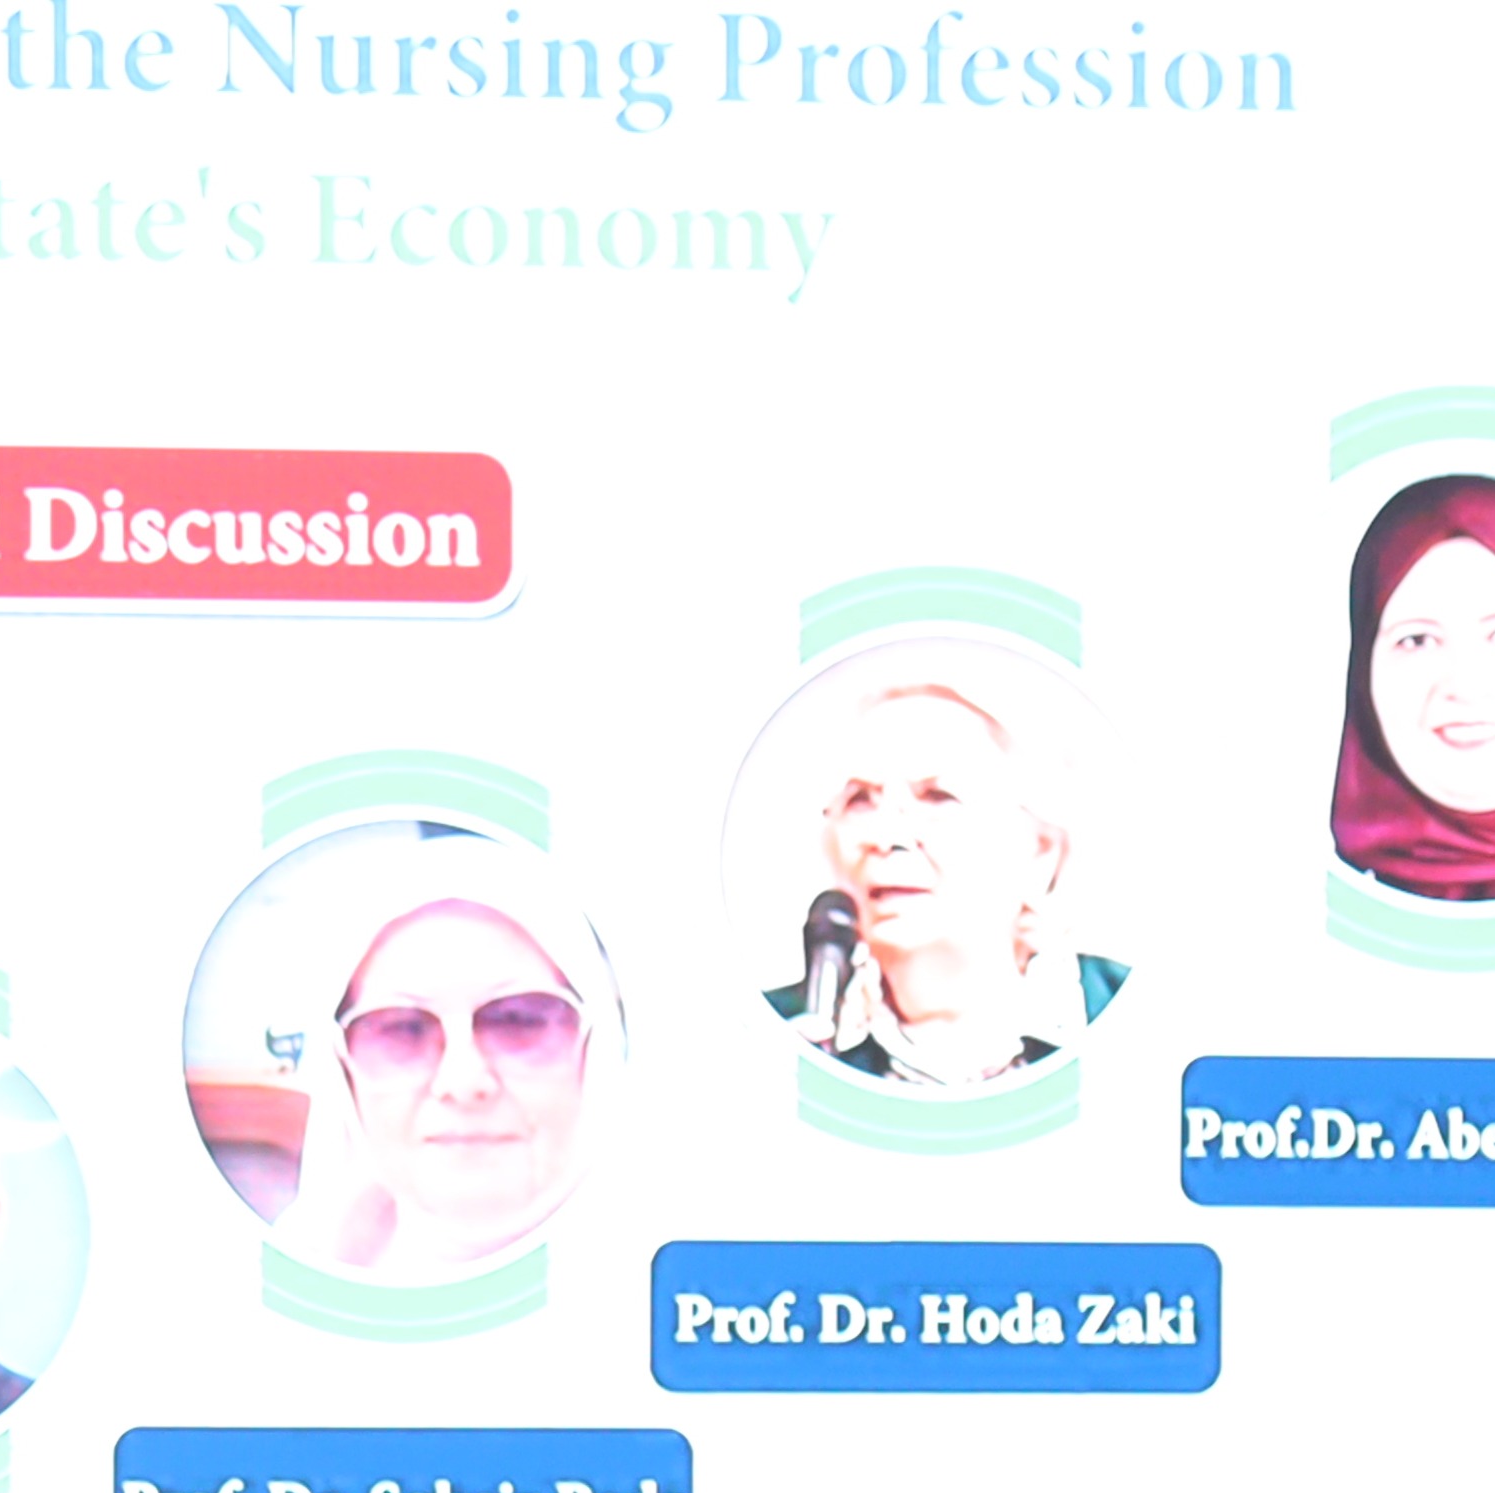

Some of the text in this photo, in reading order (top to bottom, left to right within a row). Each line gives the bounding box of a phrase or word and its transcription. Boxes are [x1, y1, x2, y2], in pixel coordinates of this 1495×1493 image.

[0, 0, 176, 94] the
[212, 0, 676, 135] Nursing
[715, 8, 1298, 113] Profession
[309, 172, 838, 306] Economy
[24, 487, 481, 568] Discussion
[1186, 1106, 1395, 1160] Prof.Dr.
[675, 1291, 1196, 1345] Prof. Dr. Hoda Zaki
